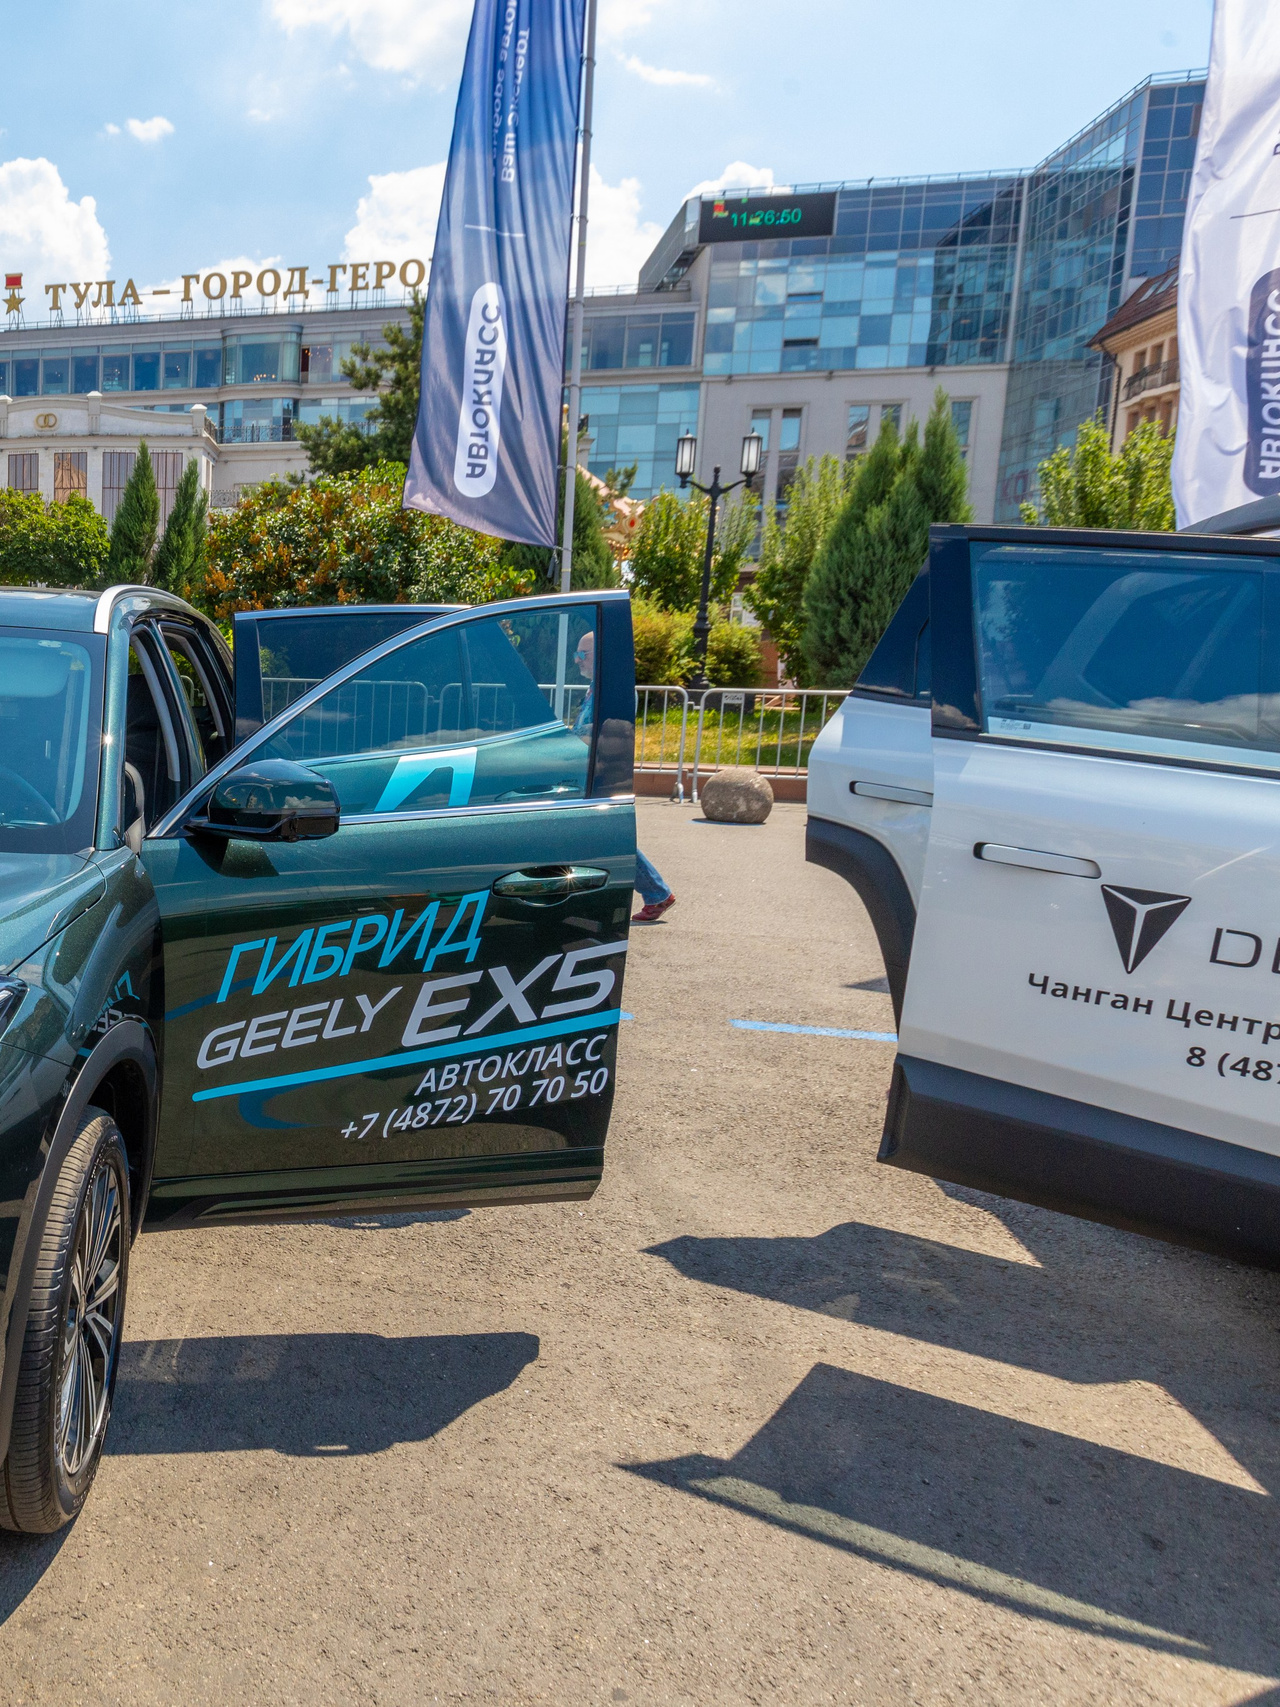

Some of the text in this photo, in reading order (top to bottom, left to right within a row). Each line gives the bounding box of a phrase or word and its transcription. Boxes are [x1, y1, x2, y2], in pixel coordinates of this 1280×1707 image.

[45, 278, 144, 311] ТУЛА
[181, 257, 431, 302] ГОРОД-ГЕРО
[217, 890, 490, 1003] ГИБРИД
[197, 986, 403, 1069] GEELY
[402, 940, 628, 1047] EX5
[1028, 972, 1280, 1045] Чанган Центр
[414, 1034, 608, 1096] АВТОКЛАСС
[1185, 1046, 1280, 1084] 8 (48
[340, 1067, 609, 1140] +7 (4872) 70 70 50
